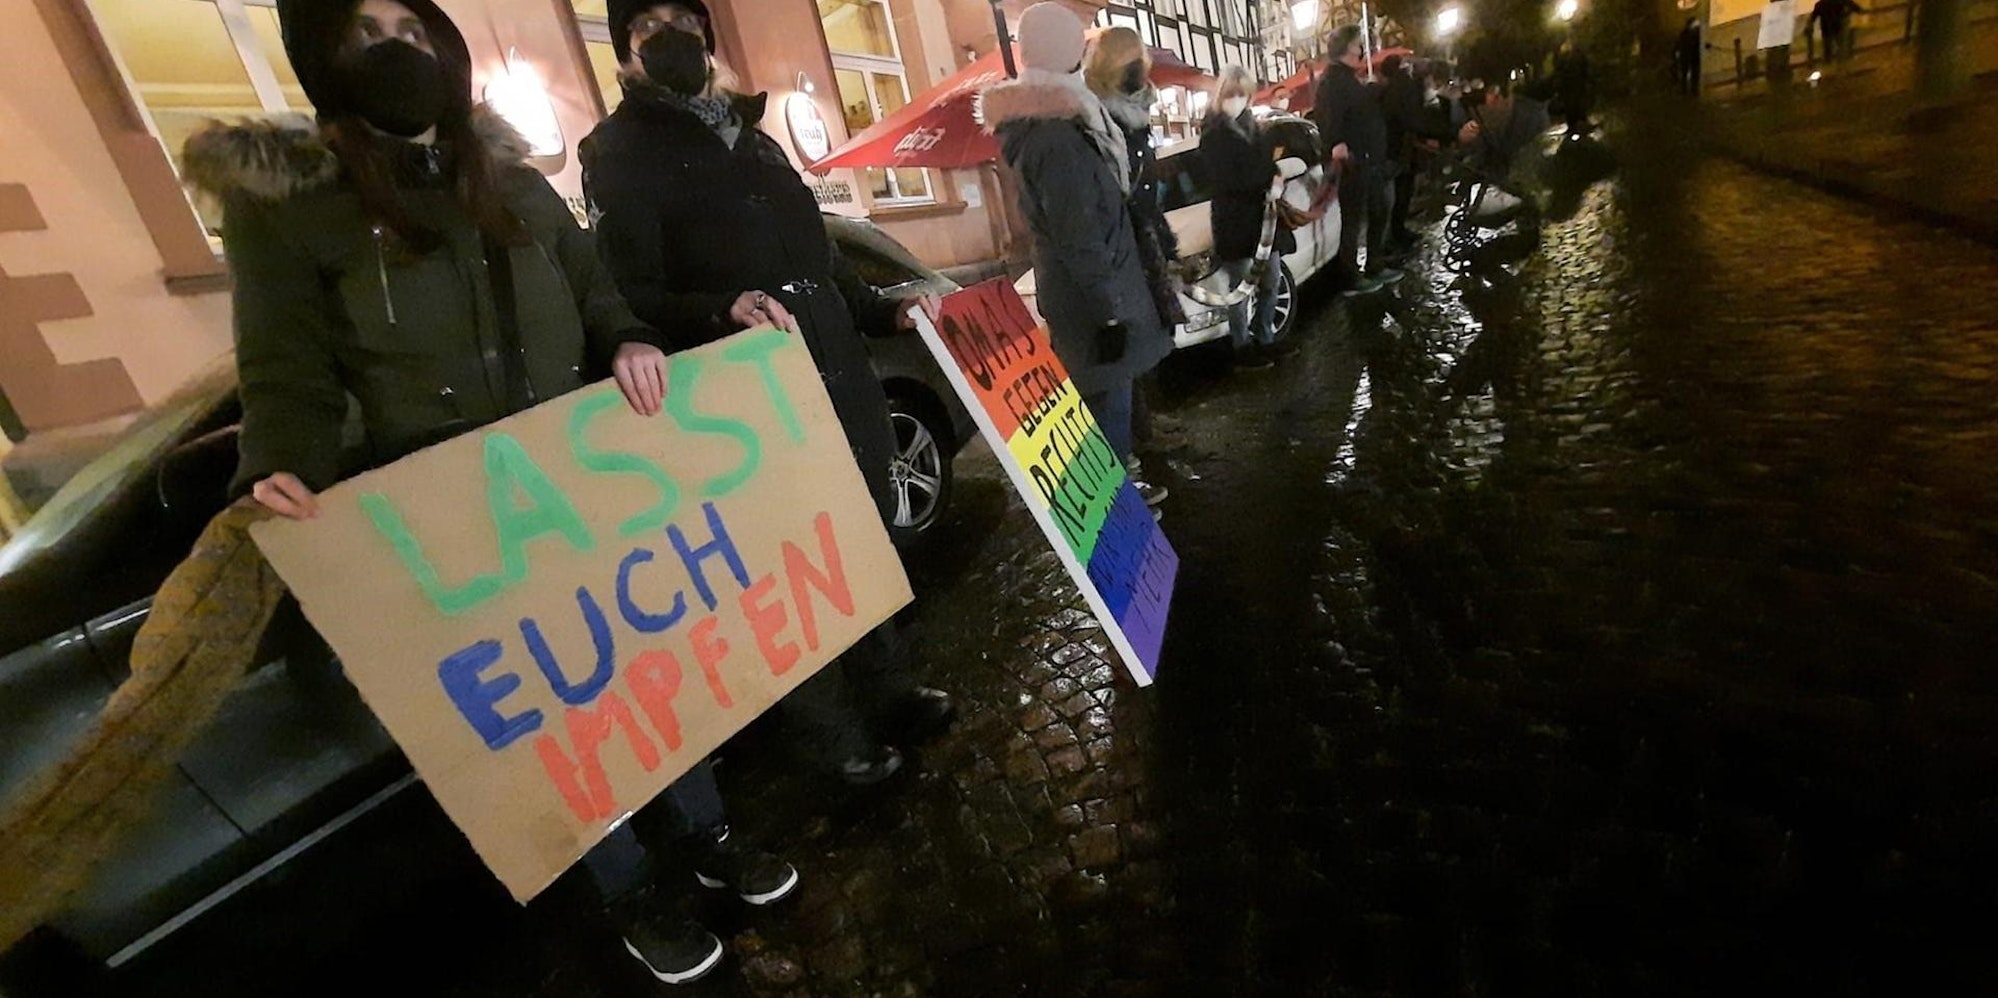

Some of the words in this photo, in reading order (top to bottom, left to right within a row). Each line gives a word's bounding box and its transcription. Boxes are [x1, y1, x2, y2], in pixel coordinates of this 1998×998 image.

[943, 281, 1037, 392] OMAS
[1002, 359, 1069, 438] GEGEN
[359, 328, 807, 616] LASST
[1029, 398, 1117, 548] RECHTS
[437, 501, 752, 751] EUCH
[533, 510, 856, 823] IMPFEN
